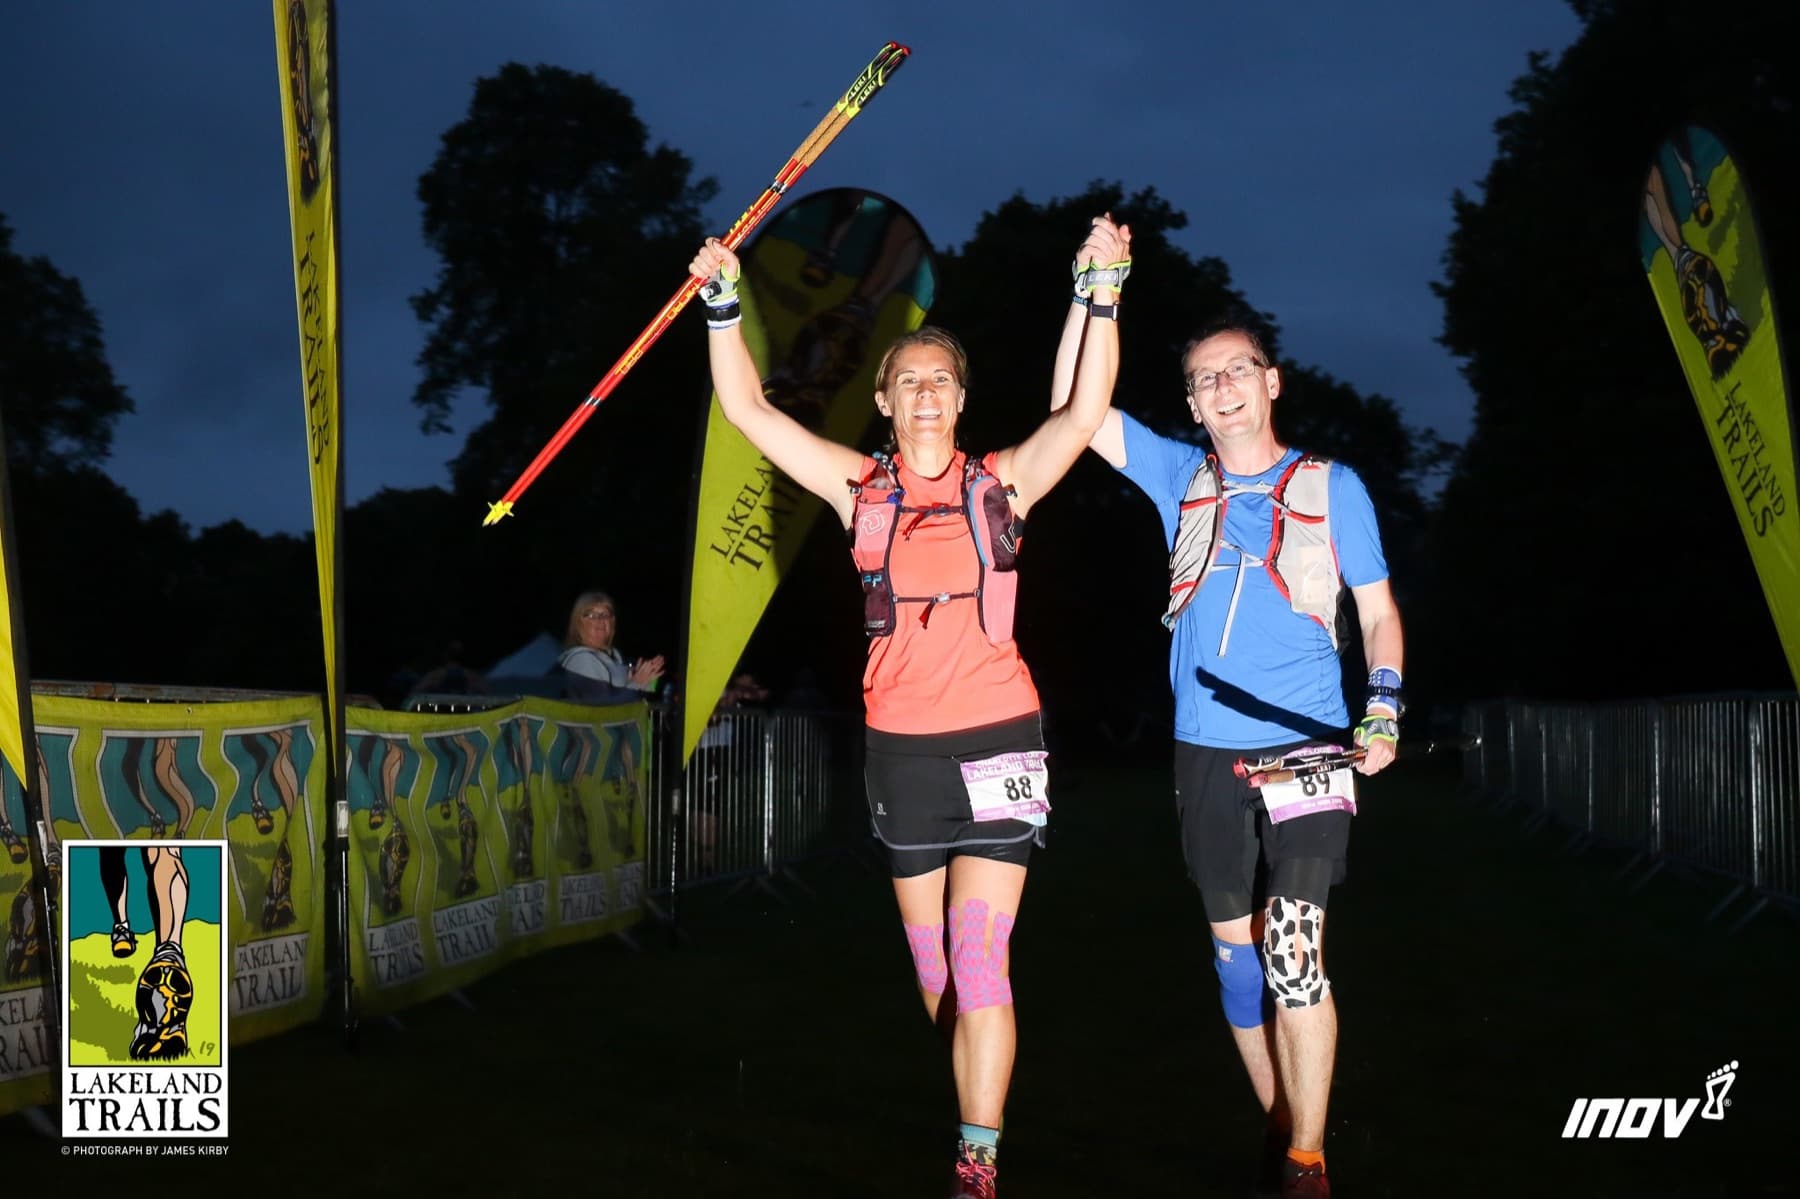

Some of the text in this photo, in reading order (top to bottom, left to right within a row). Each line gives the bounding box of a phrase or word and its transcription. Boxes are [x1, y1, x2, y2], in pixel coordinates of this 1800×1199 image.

[860, 80, 876, 103] LEKI
[300, 239, 323, 464] TRAILS
[1717, 397, 1774, 537] TRAILS
[1726, 380, 1785, 517] LAKELAND
[711, 456, 774, 557] LAKELA
[1004, 775, 1033, 802] 88
[1300, 773, 1331, 797] 89
